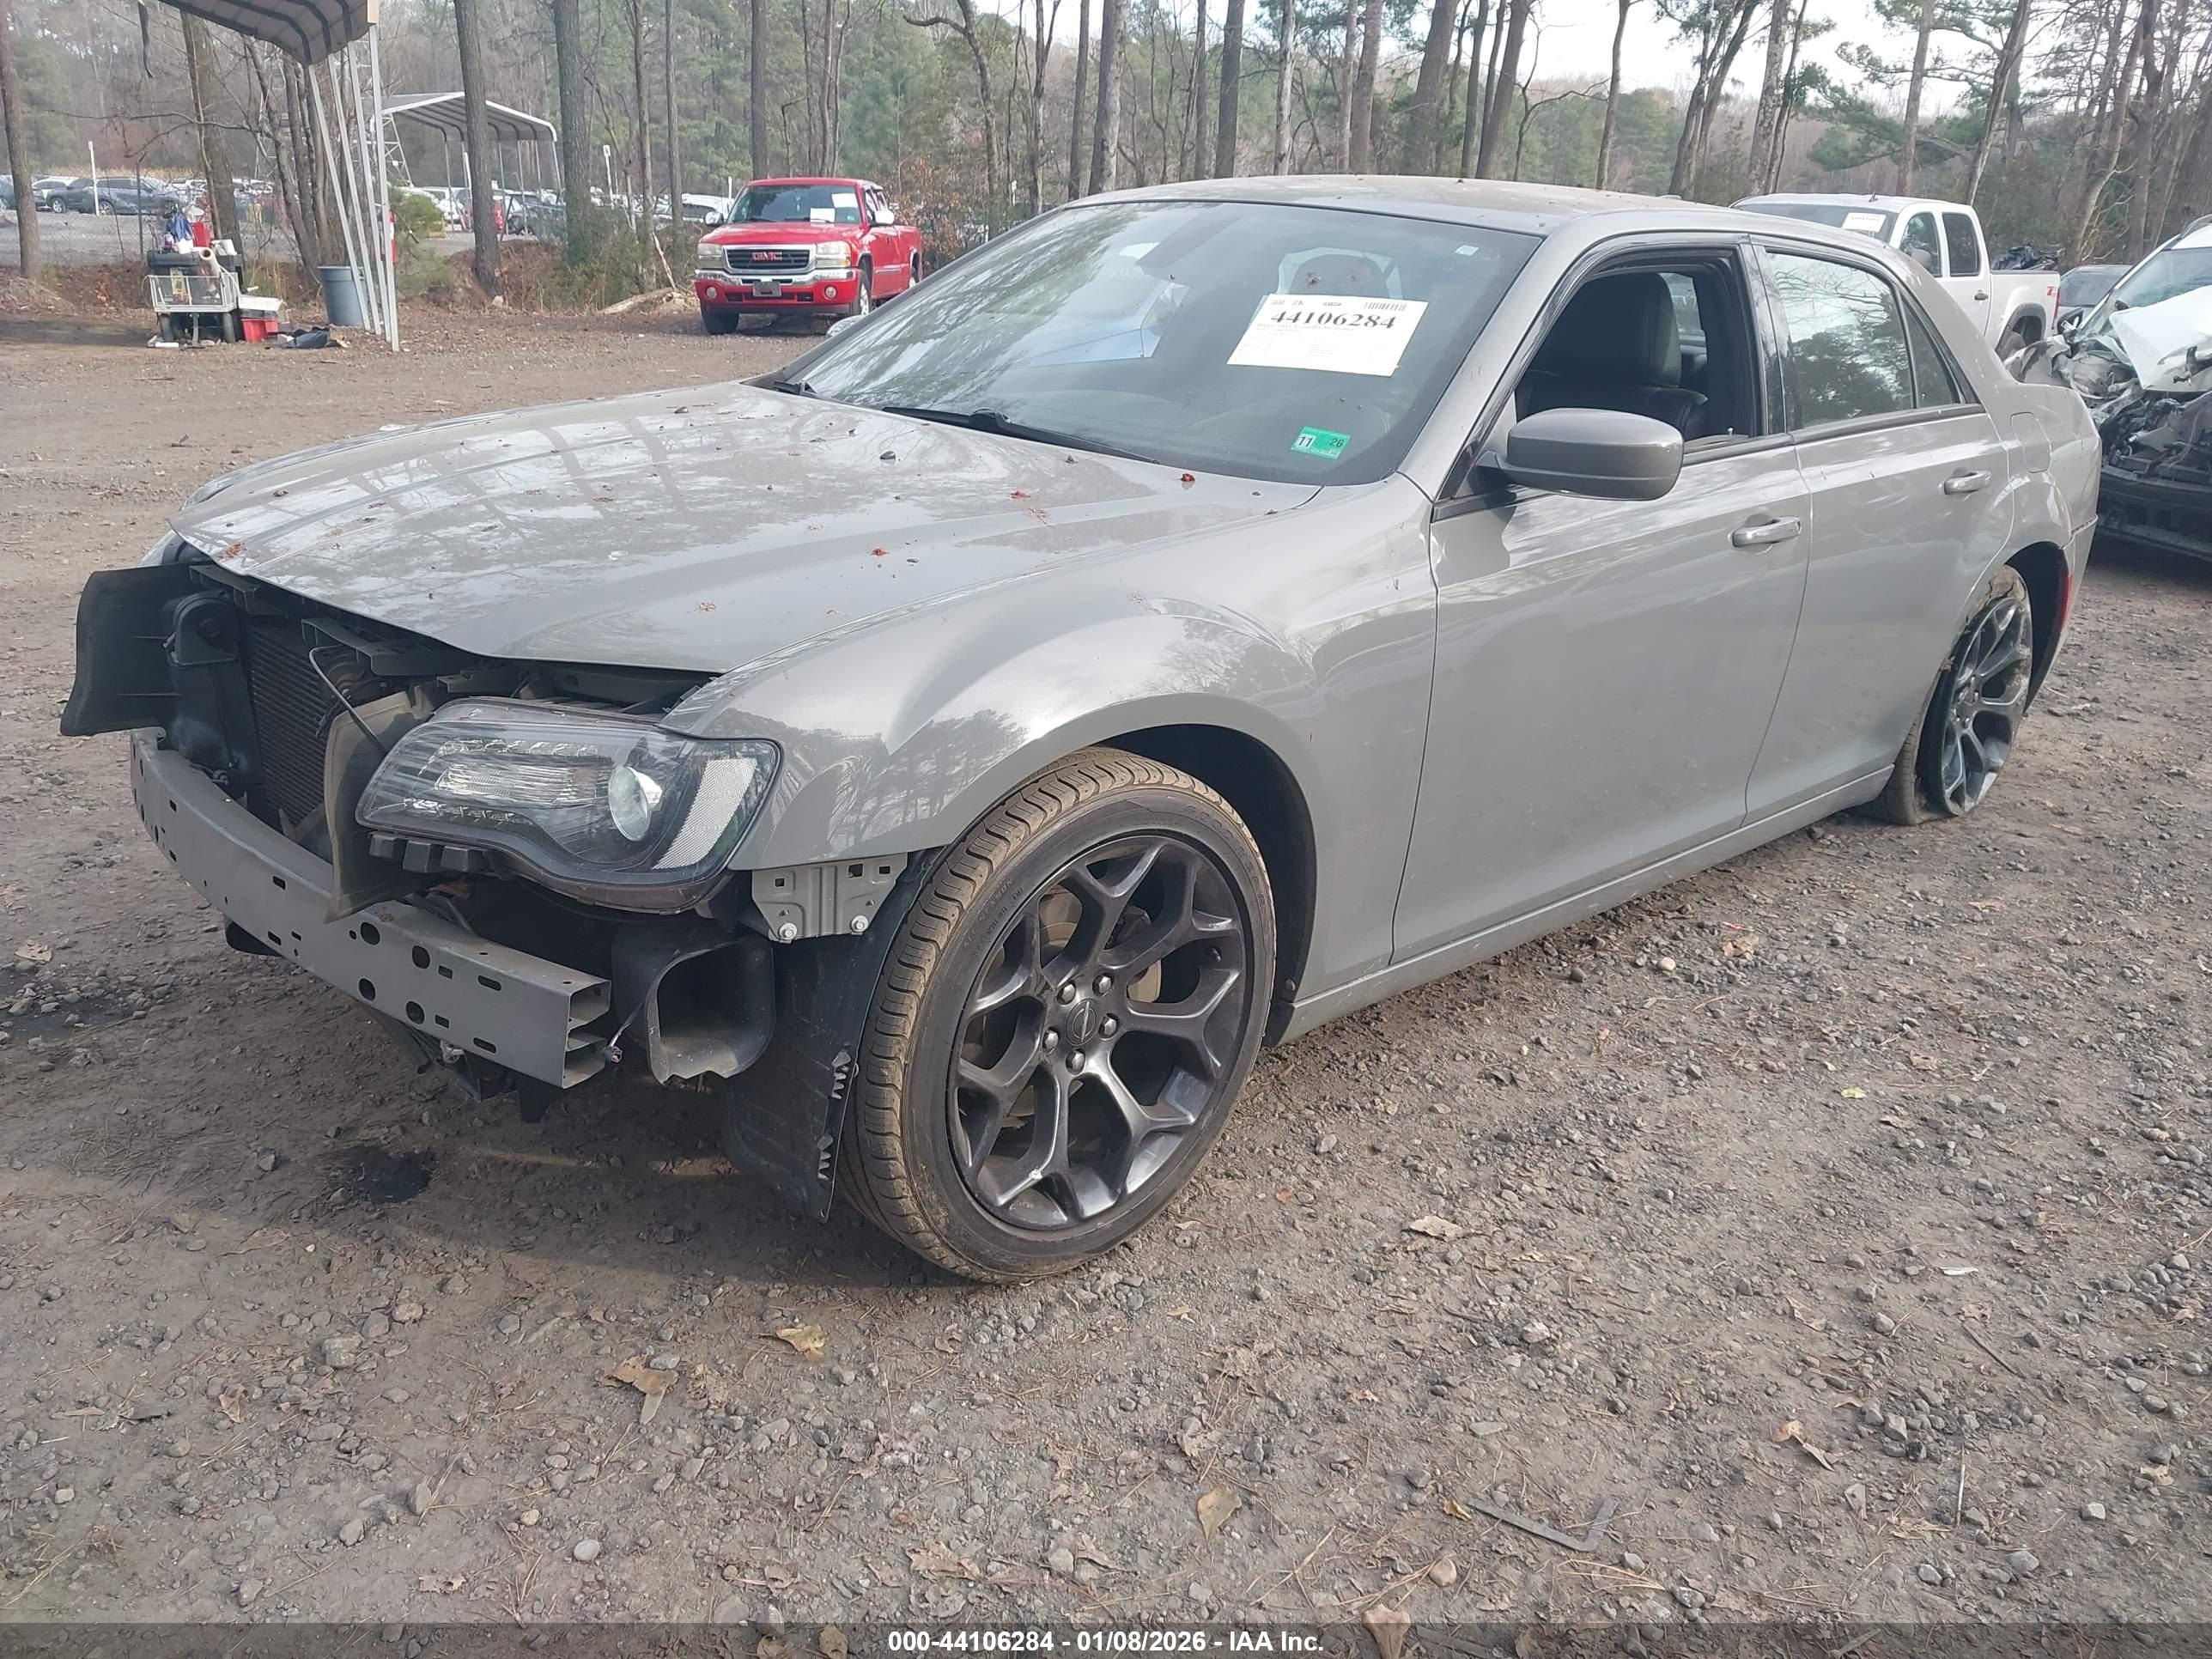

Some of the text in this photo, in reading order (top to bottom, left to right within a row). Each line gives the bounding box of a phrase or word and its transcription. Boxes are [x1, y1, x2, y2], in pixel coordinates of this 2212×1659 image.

[751, 252, 783, 261] GMC
[1271, 311, 1397, 329] 44106284
[1297, 436, 1346, 447] 11 26
